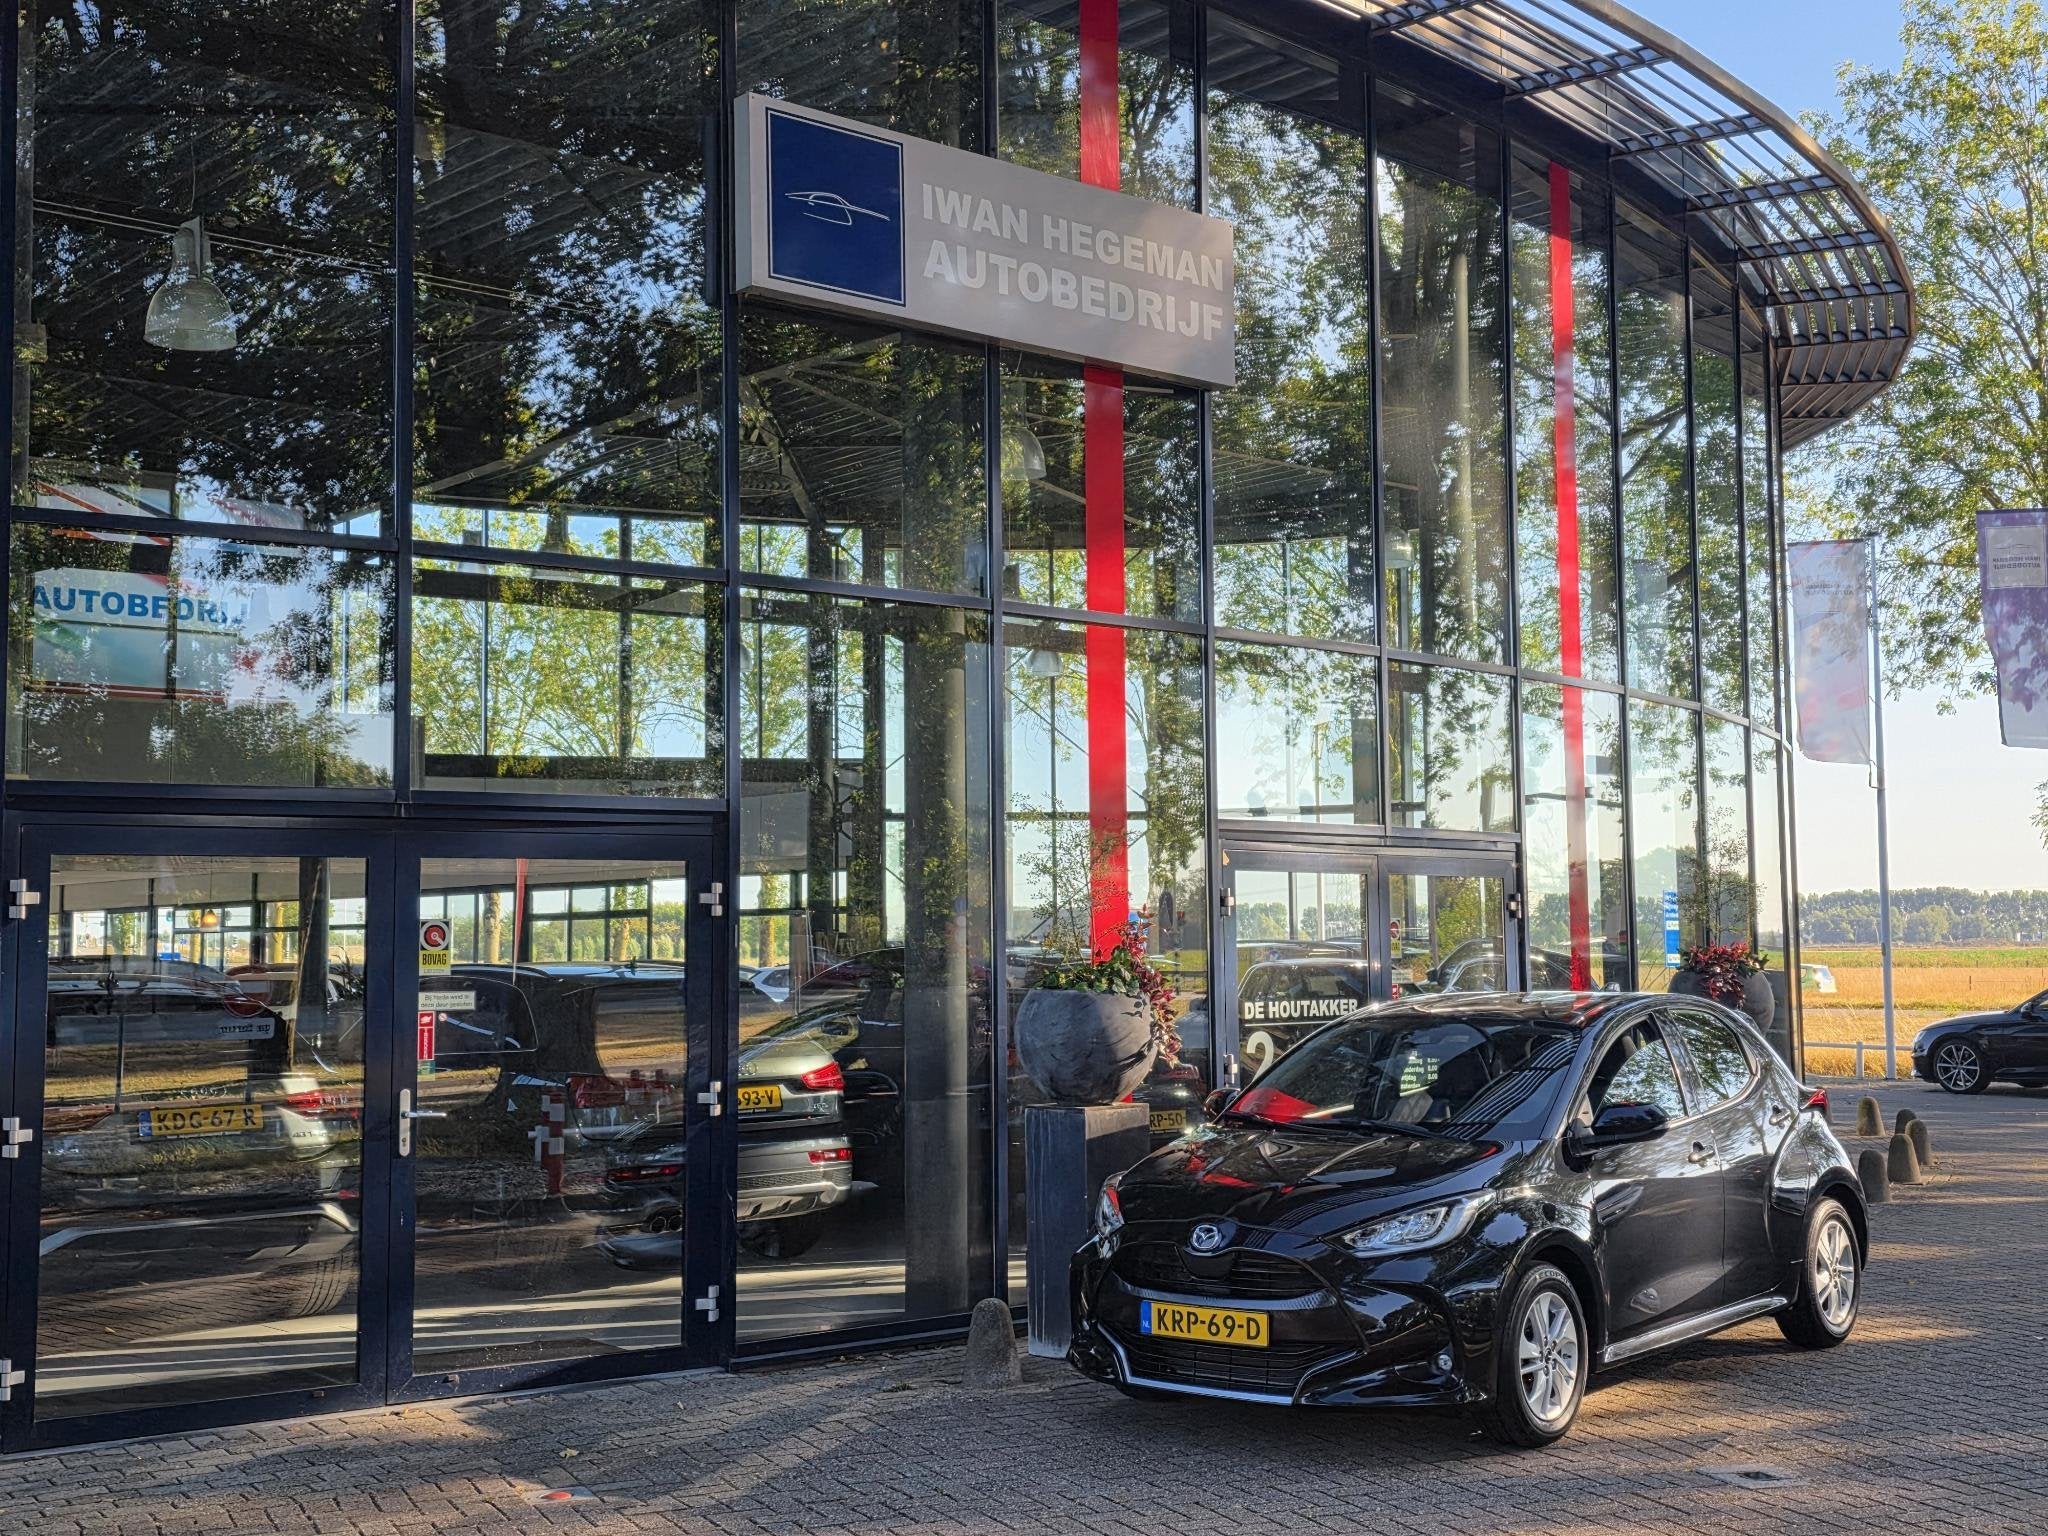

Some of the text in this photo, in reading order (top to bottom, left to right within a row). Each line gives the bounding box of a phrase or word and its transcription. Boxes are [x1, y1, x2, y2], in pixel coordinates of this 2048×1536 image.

[922, 183, 1224, 292] IWAN HEGEMAN
[923, 239, 1224, 341] AUTOBEDRIJF
[422, 953, 447, 966] BOVAG
[1244, 998, 1359, 1020] DE HOUTAKKER
[157, 1107, 257, 1132] KDG-67R
[1156, 1307, 1261, 1341] KRP-69-D
